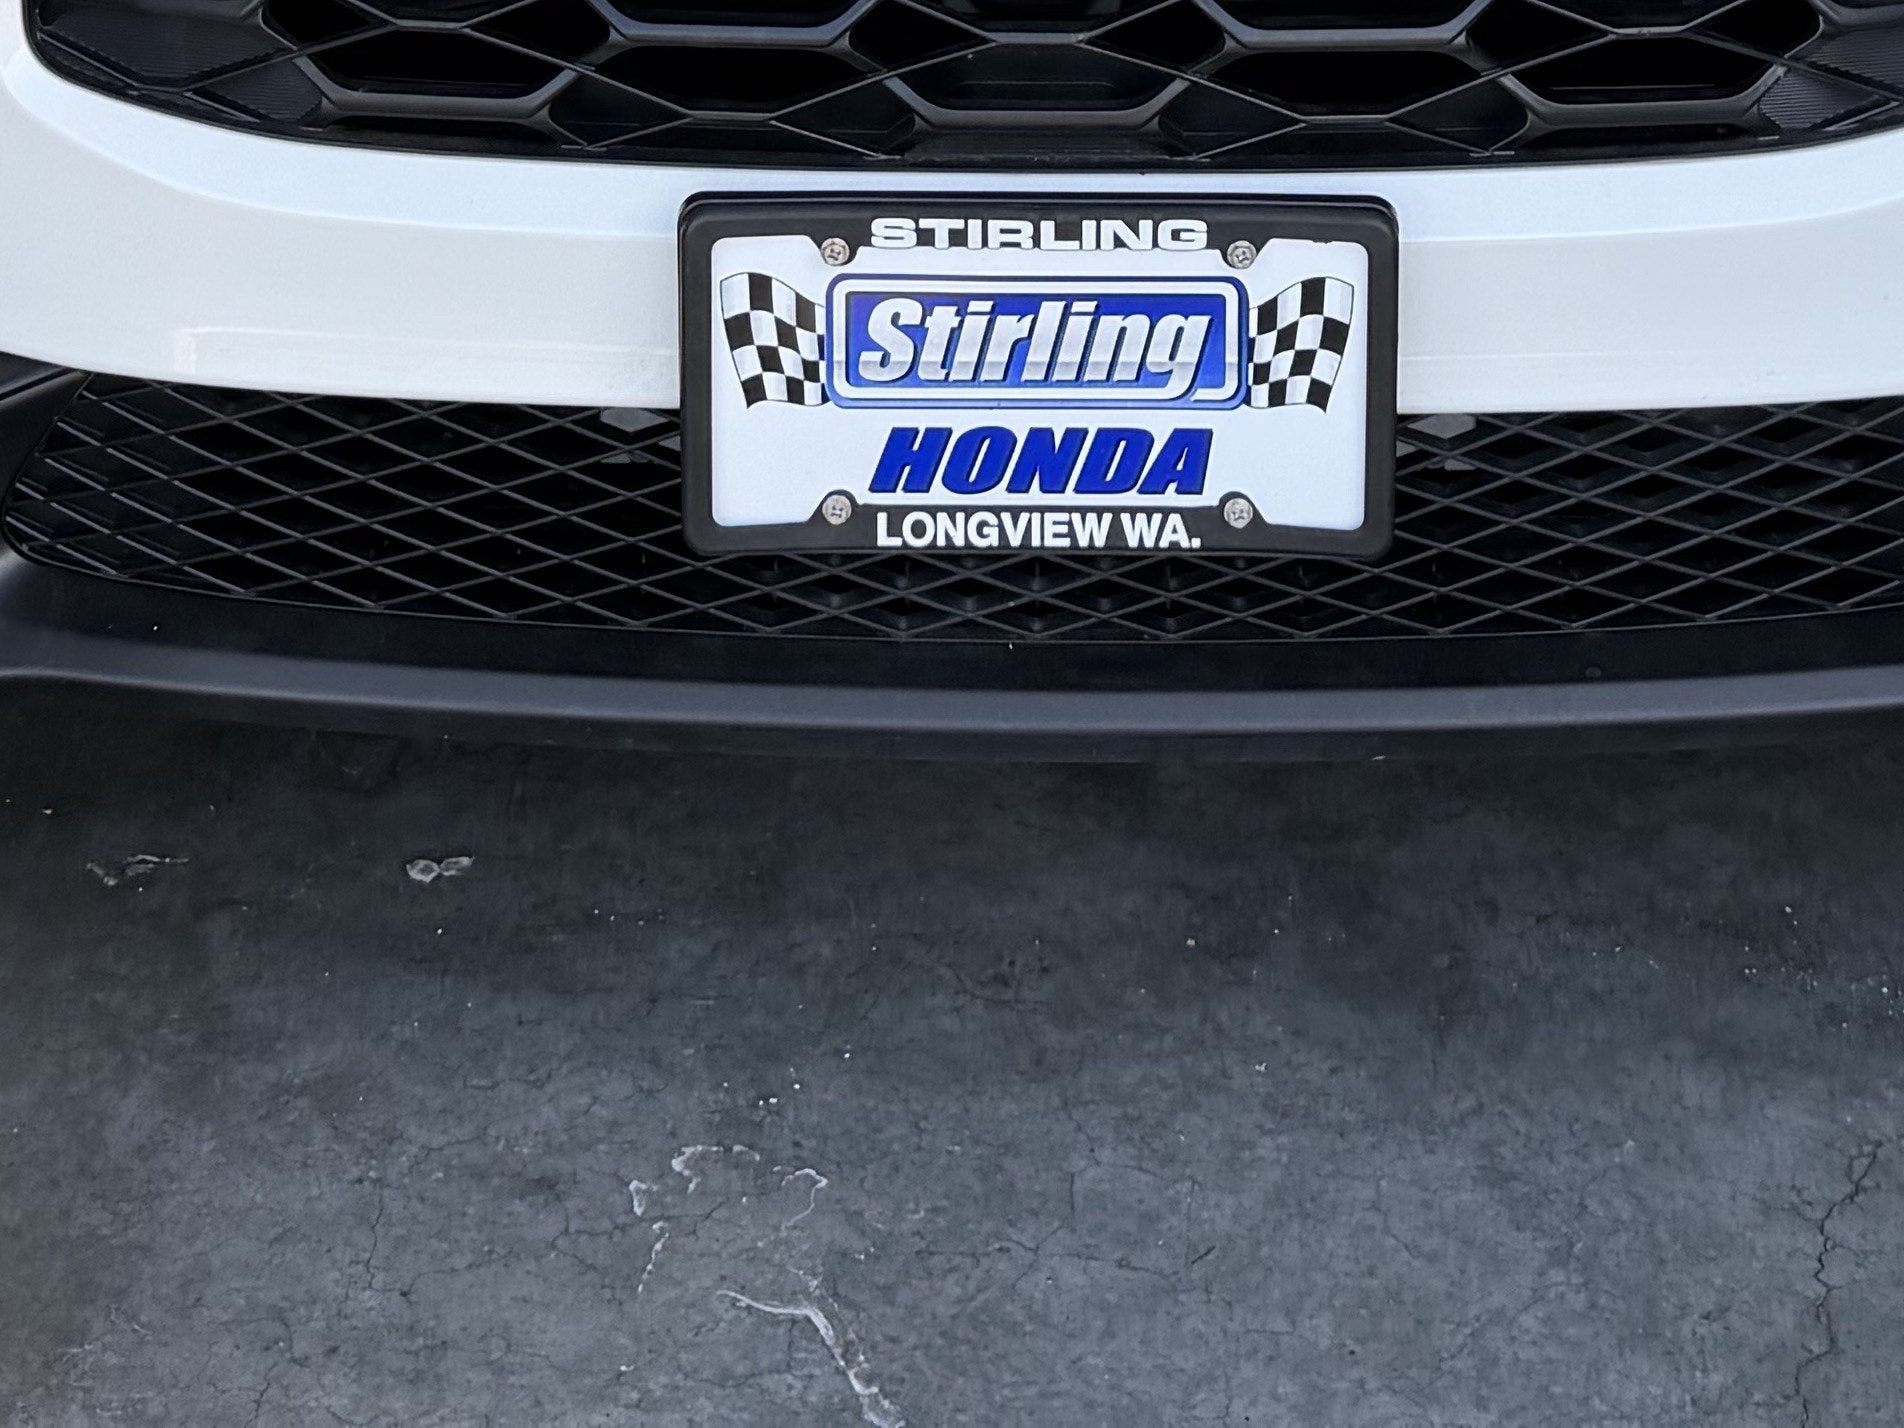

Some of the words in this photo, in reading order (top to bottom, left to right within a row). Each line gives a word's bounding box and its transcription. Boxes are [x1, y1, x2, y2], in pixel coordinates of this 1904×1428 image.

[869, 216, 1208, 251] STIRLING
[857, 296, 1218, 401] Stirling
[867, 426, 1214, 496] HONDA
[875, 510, 1117, 549] LONGVIEW
[1120, 510, 1202, 548] WA.
